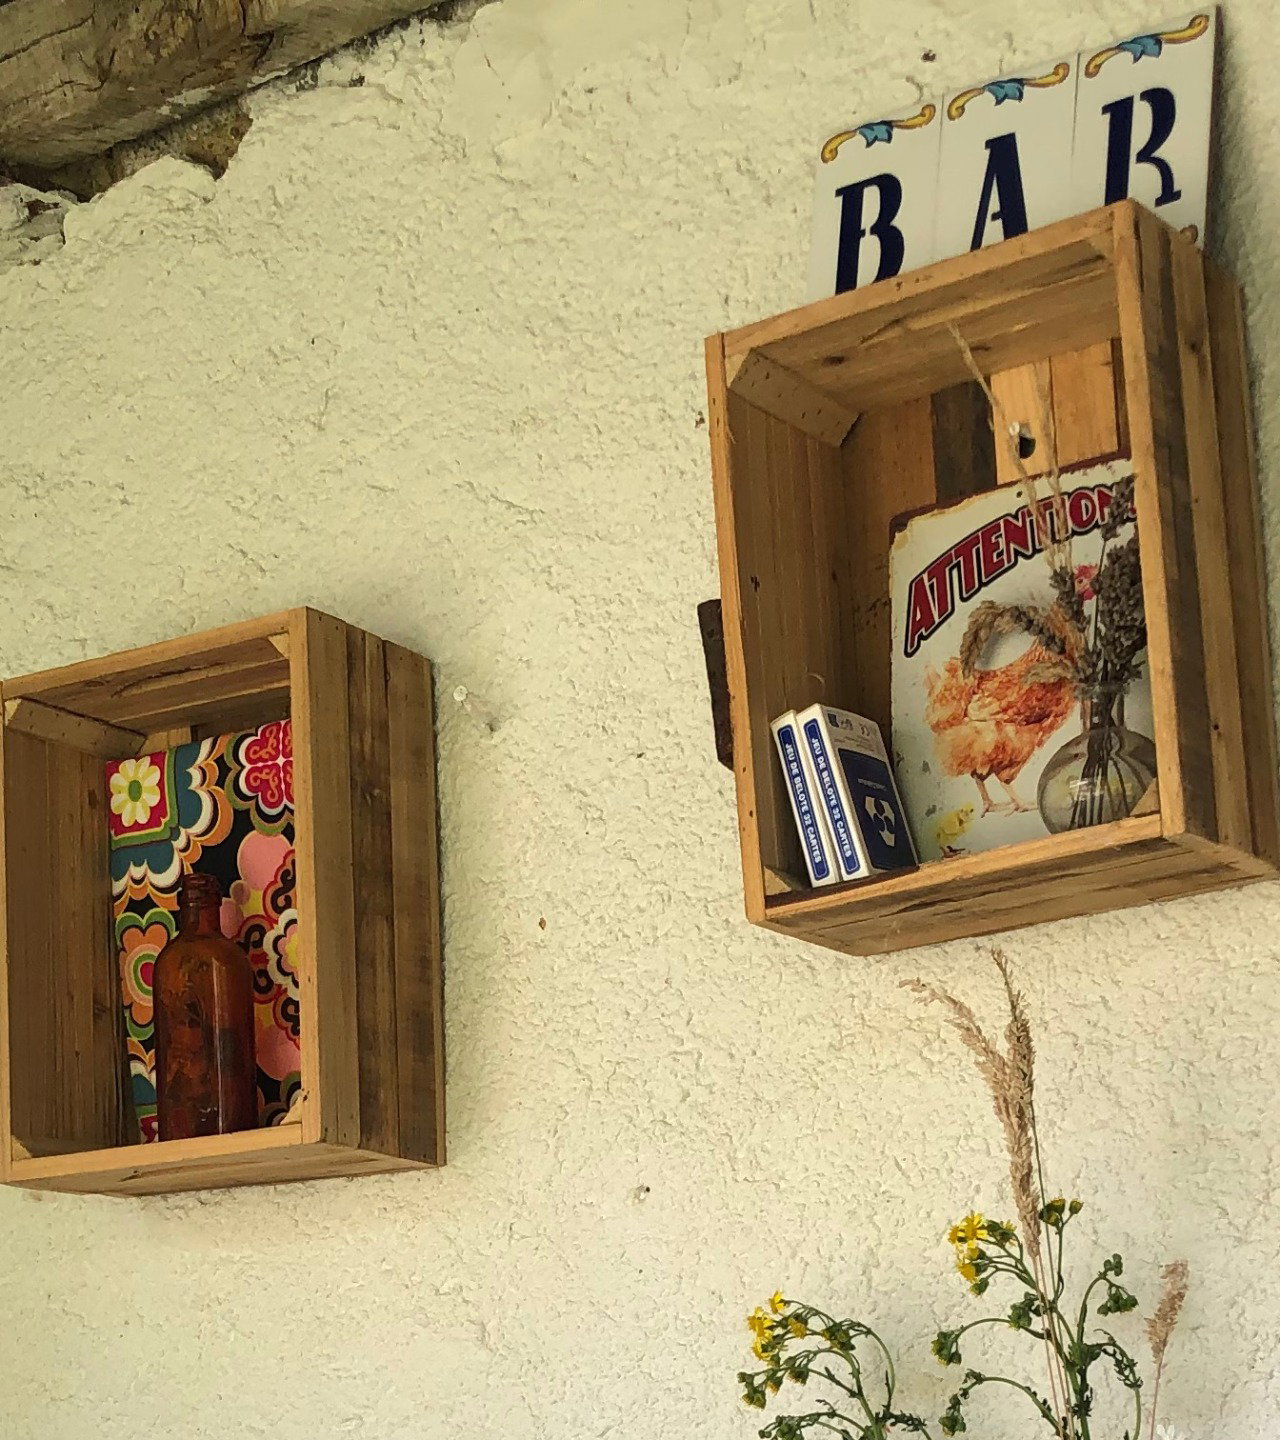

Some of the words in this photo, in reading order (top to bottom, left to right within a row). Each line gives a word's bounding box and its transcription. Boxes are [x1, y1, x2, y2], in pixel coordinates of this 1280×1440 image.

[835, 87, 1182, 295] BAR
[785, 743, 795, 761] JEU
[811, 737, 821, 755] JEU
[790, 762, 800, 776] DE
[817, 755, 827, 770] DE
[793, 776, 807, 812] BELOTE
[821, 770, 837, 807] BELOTE
[803, 812, 811, 826] 32
[832, 808, 840, 821] 32
[806, 826, 822, 864] CARTES
[836, 821, 852, 858] CARTES
